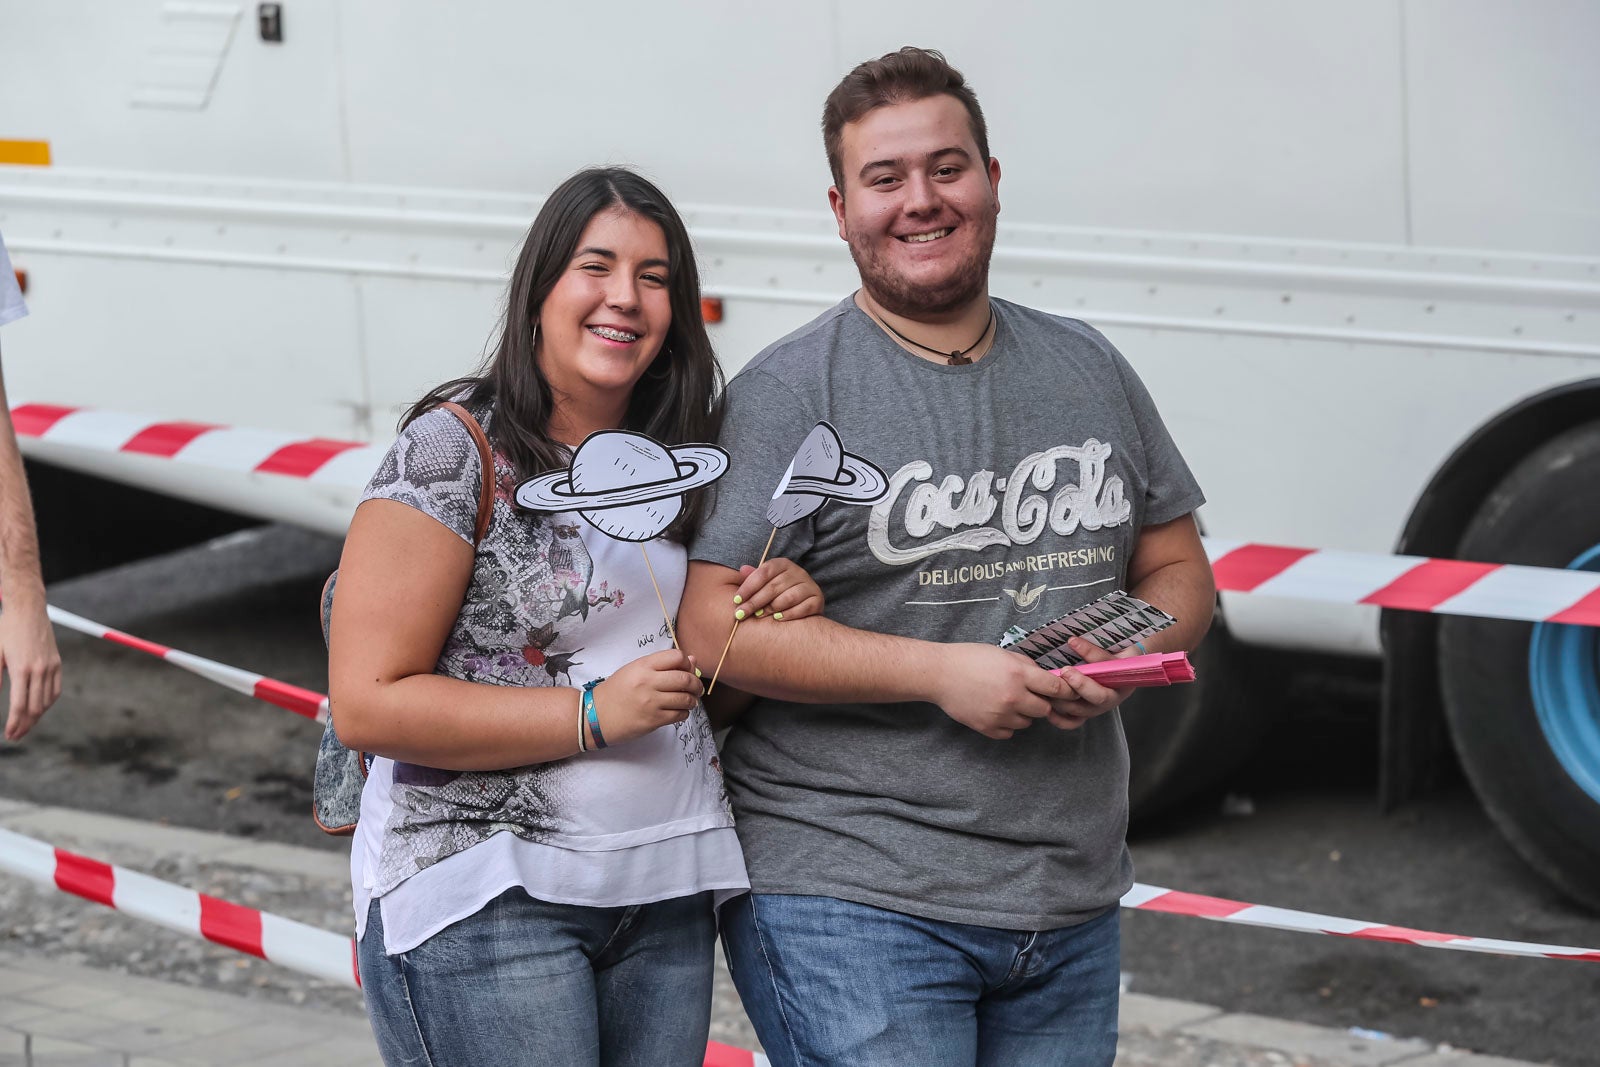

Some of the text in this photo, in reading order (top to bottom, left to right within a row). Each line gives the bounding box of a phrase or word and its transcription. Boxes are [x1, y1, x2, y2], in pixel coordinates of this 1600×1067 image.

[919, 546, 1115, 586] DELICIOUS AND REFRESHING
